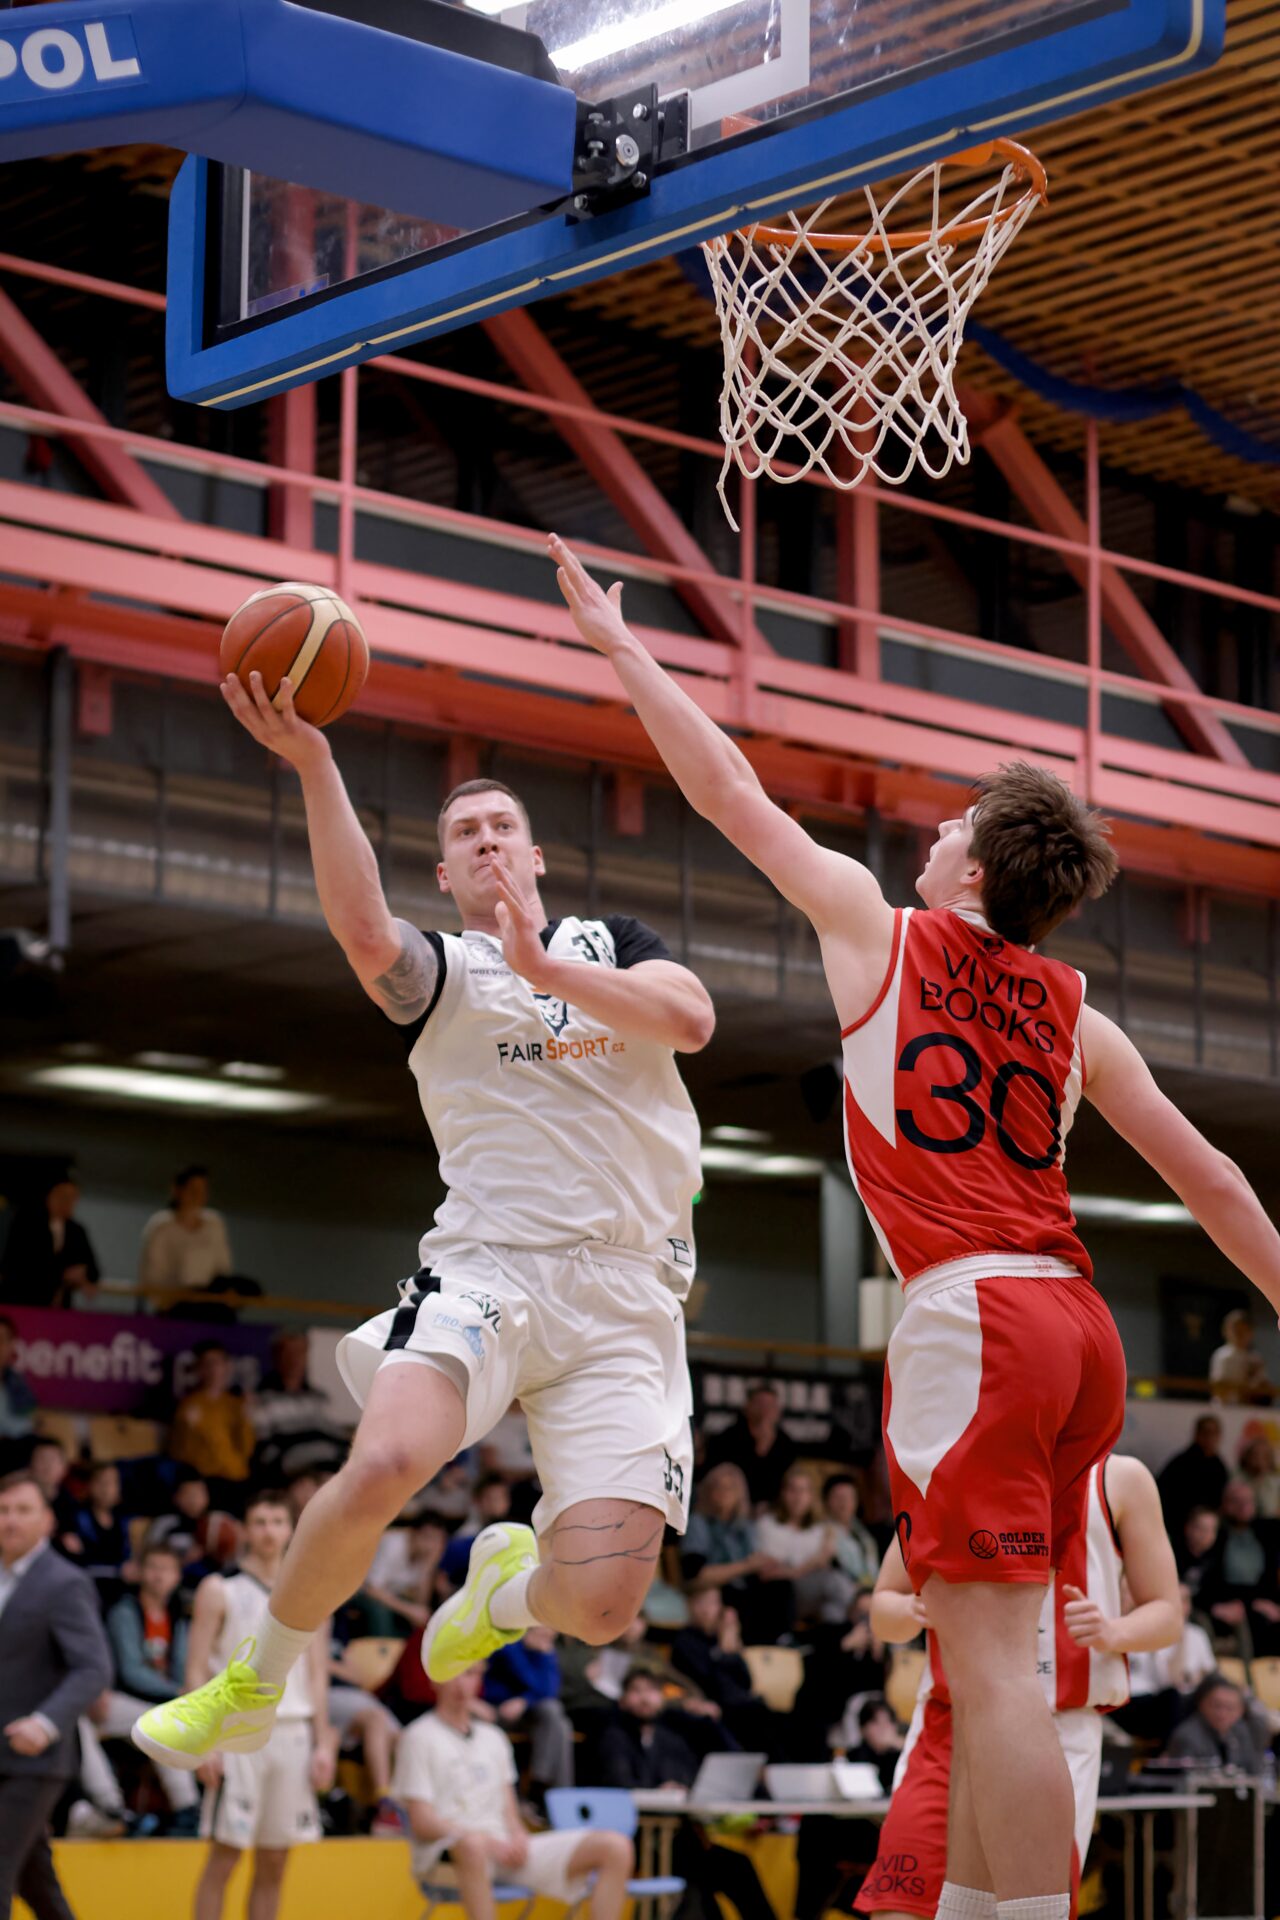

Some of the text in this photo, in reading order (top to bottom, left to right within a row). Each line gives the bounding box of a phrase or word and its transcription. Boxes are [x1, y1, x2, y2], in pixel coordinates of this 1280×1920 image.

[942, 944, 1048, 1010] VIVID
[920, 976, 1057, 1054] BOOKS
[896, 1031, 1062, 1171] 30
[999, 1532, 1045, 1544] GOLDEN
